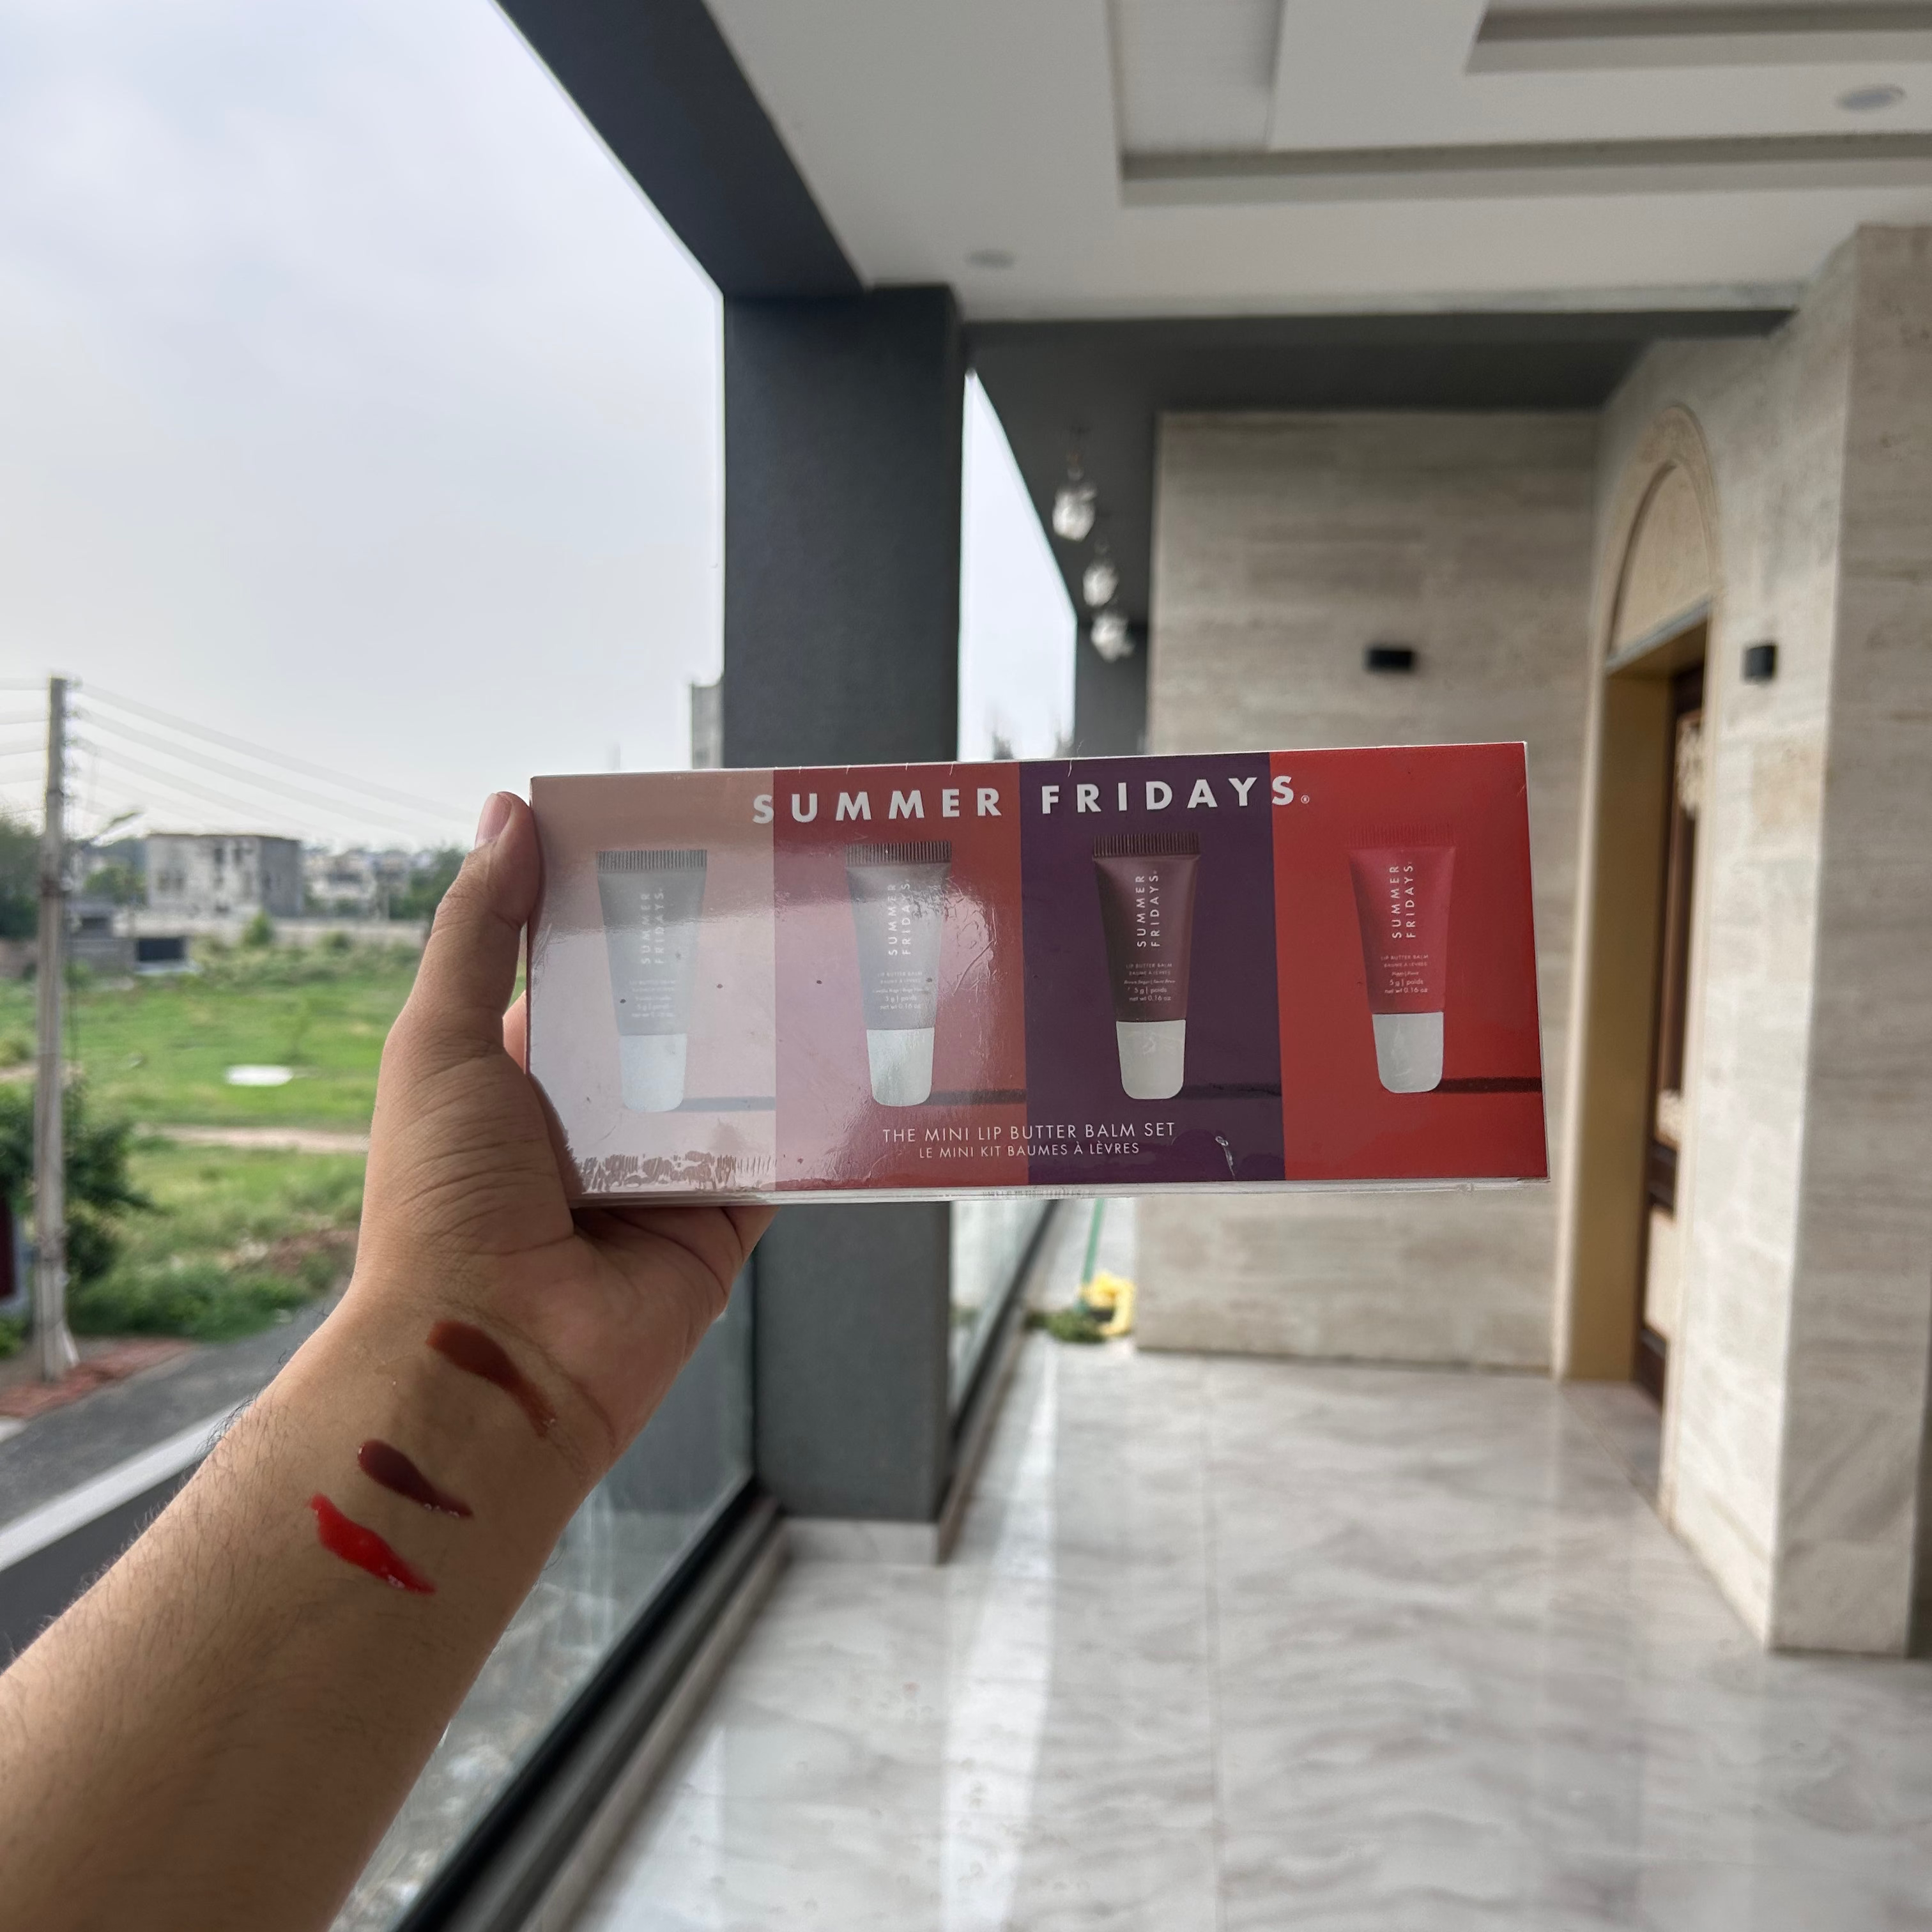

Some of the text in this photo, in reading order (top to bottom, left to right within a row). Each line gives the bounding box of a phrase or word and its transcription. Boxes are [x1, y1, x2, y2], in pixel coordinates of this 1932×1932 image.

[751, 787, 1002, 824] SUMMER
[640, 893, 651, 965] SUMMER
[887, 884, 898, 956] SUMMER
[1135, 875, 1147, 948] SUMMER
[1389, 866, 1402, 939] SUMMER
[882, 1121, 1175, 1143] THE MINI LIP BUTTER BALM SET
[919, 1140, 1139, 1158] LE MINI KIT BAUMES À LÈVRES
